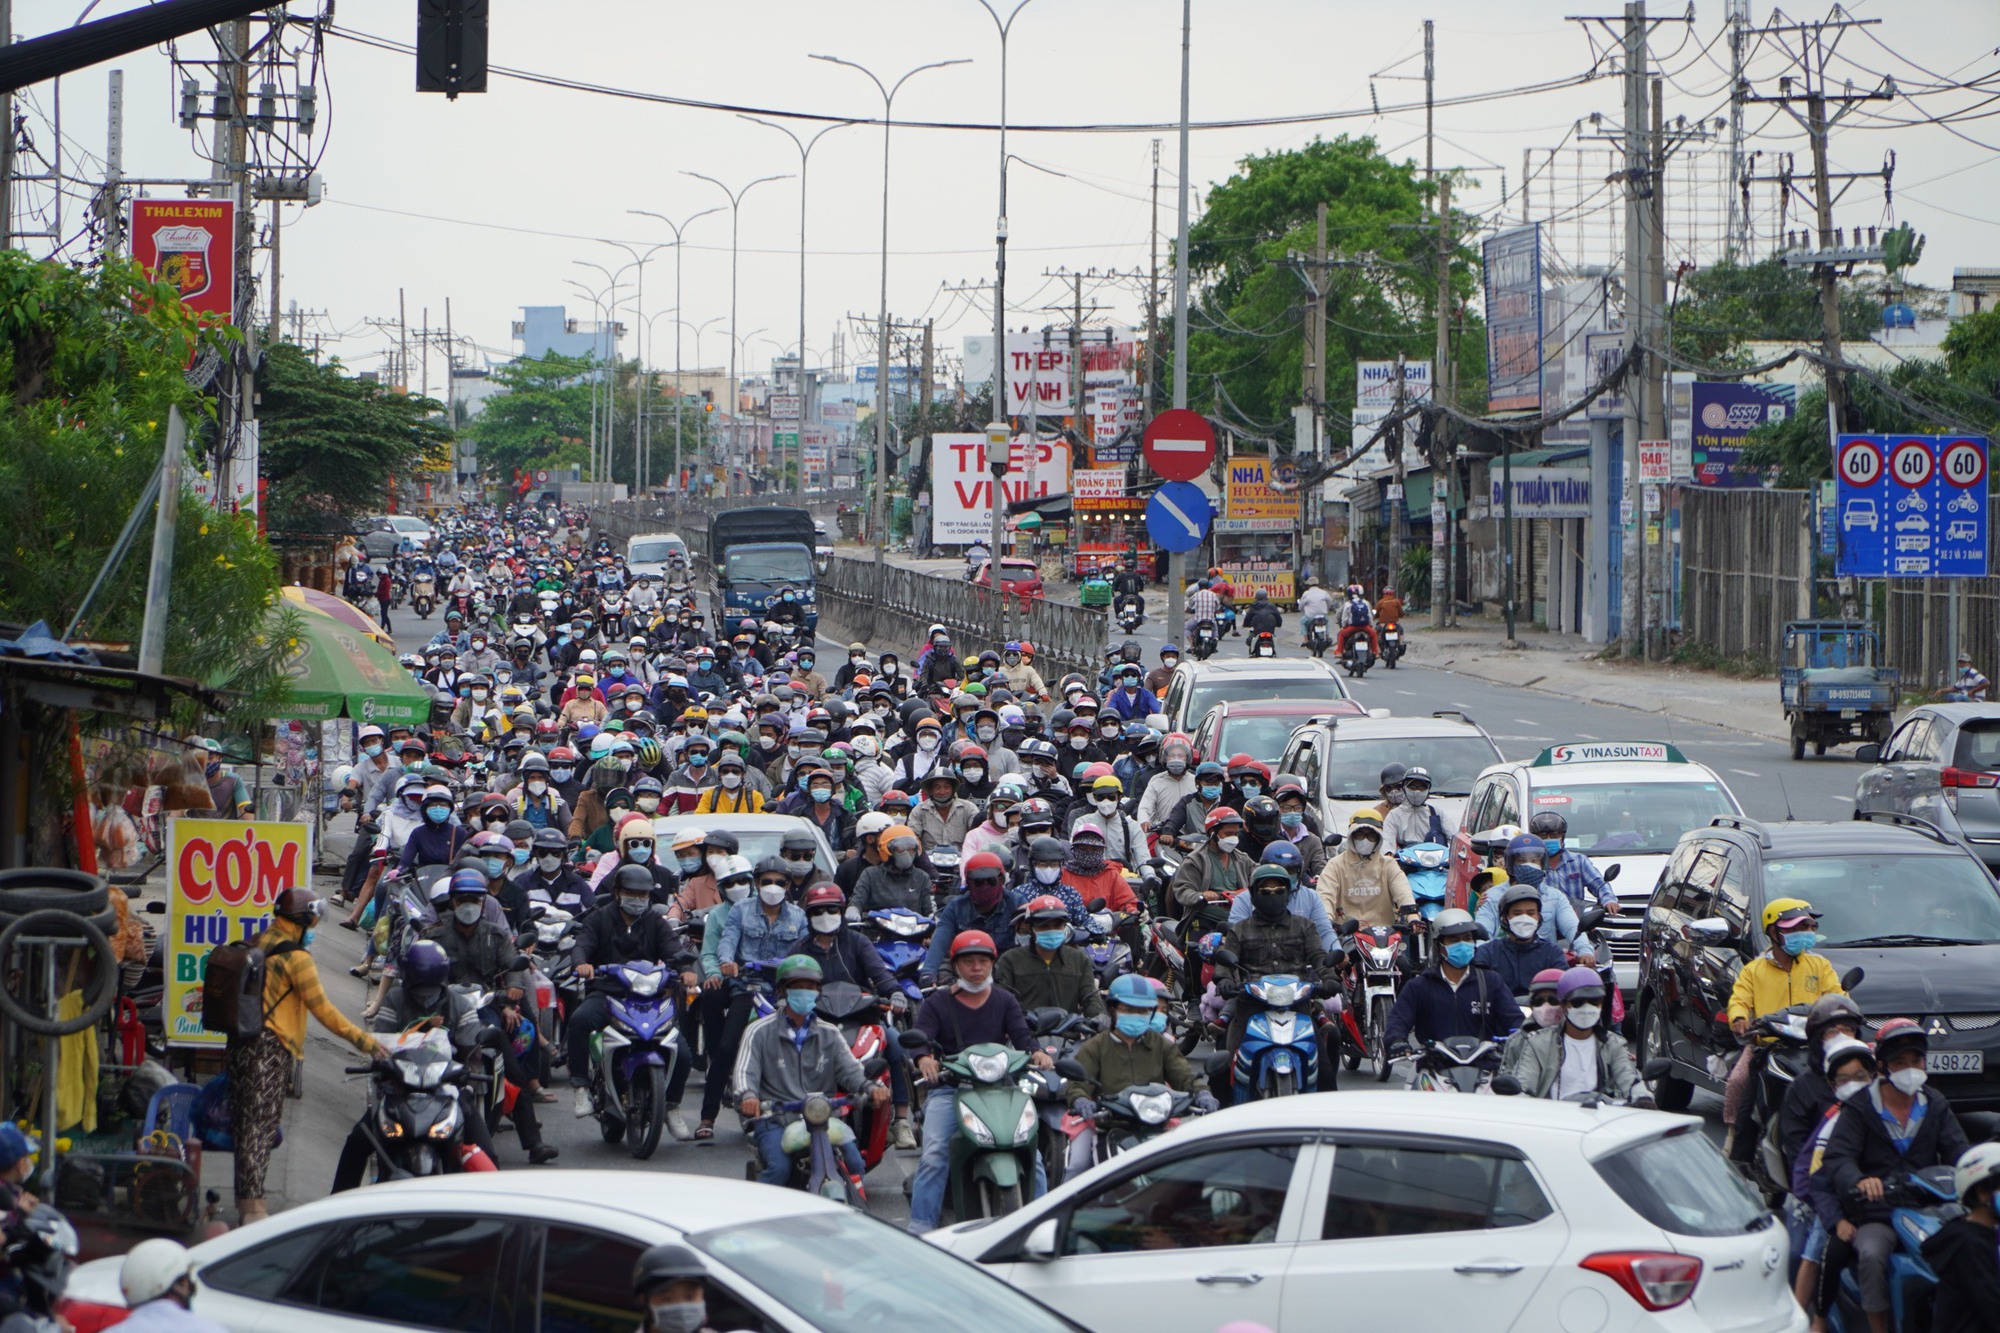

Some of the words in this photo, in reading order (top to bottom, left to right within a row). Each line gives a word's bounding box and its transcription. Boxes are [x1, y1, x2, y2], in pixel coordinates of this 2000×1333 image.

[144, 206, 222, 218] THALEXIM
[1363, 365, 1389, 380] NHÀ
[1729, 406, 1759, 420] SSSC
[1697, 434, 1718, 446] TÔN
[1641, 453, 1662, 465] 640
[1850, 453, 1871, 474] 60
[1902, 453, 1924, 475] 60
[1953, 453, 1975, 475] 60
[1232, 463, 1264, 484] NHÀ
[1076, 476, 1104, 488] HOÀNG
[1107, 479, 1123, 488] HUY
[1516, 474, 1550, 509] THUẬN
[1552, 476, 1589, 505] THÀNH
[1941, 550, 1947, 560] XE
[1949, 550, 1953, 560] 2
[1968, 547, 1983, 560] BÁNH
[1253, 574, 1277, 583] QUAY
[1348, 887, 1380, 896] PORTO
[184, 909, 228, 946] HỦ
